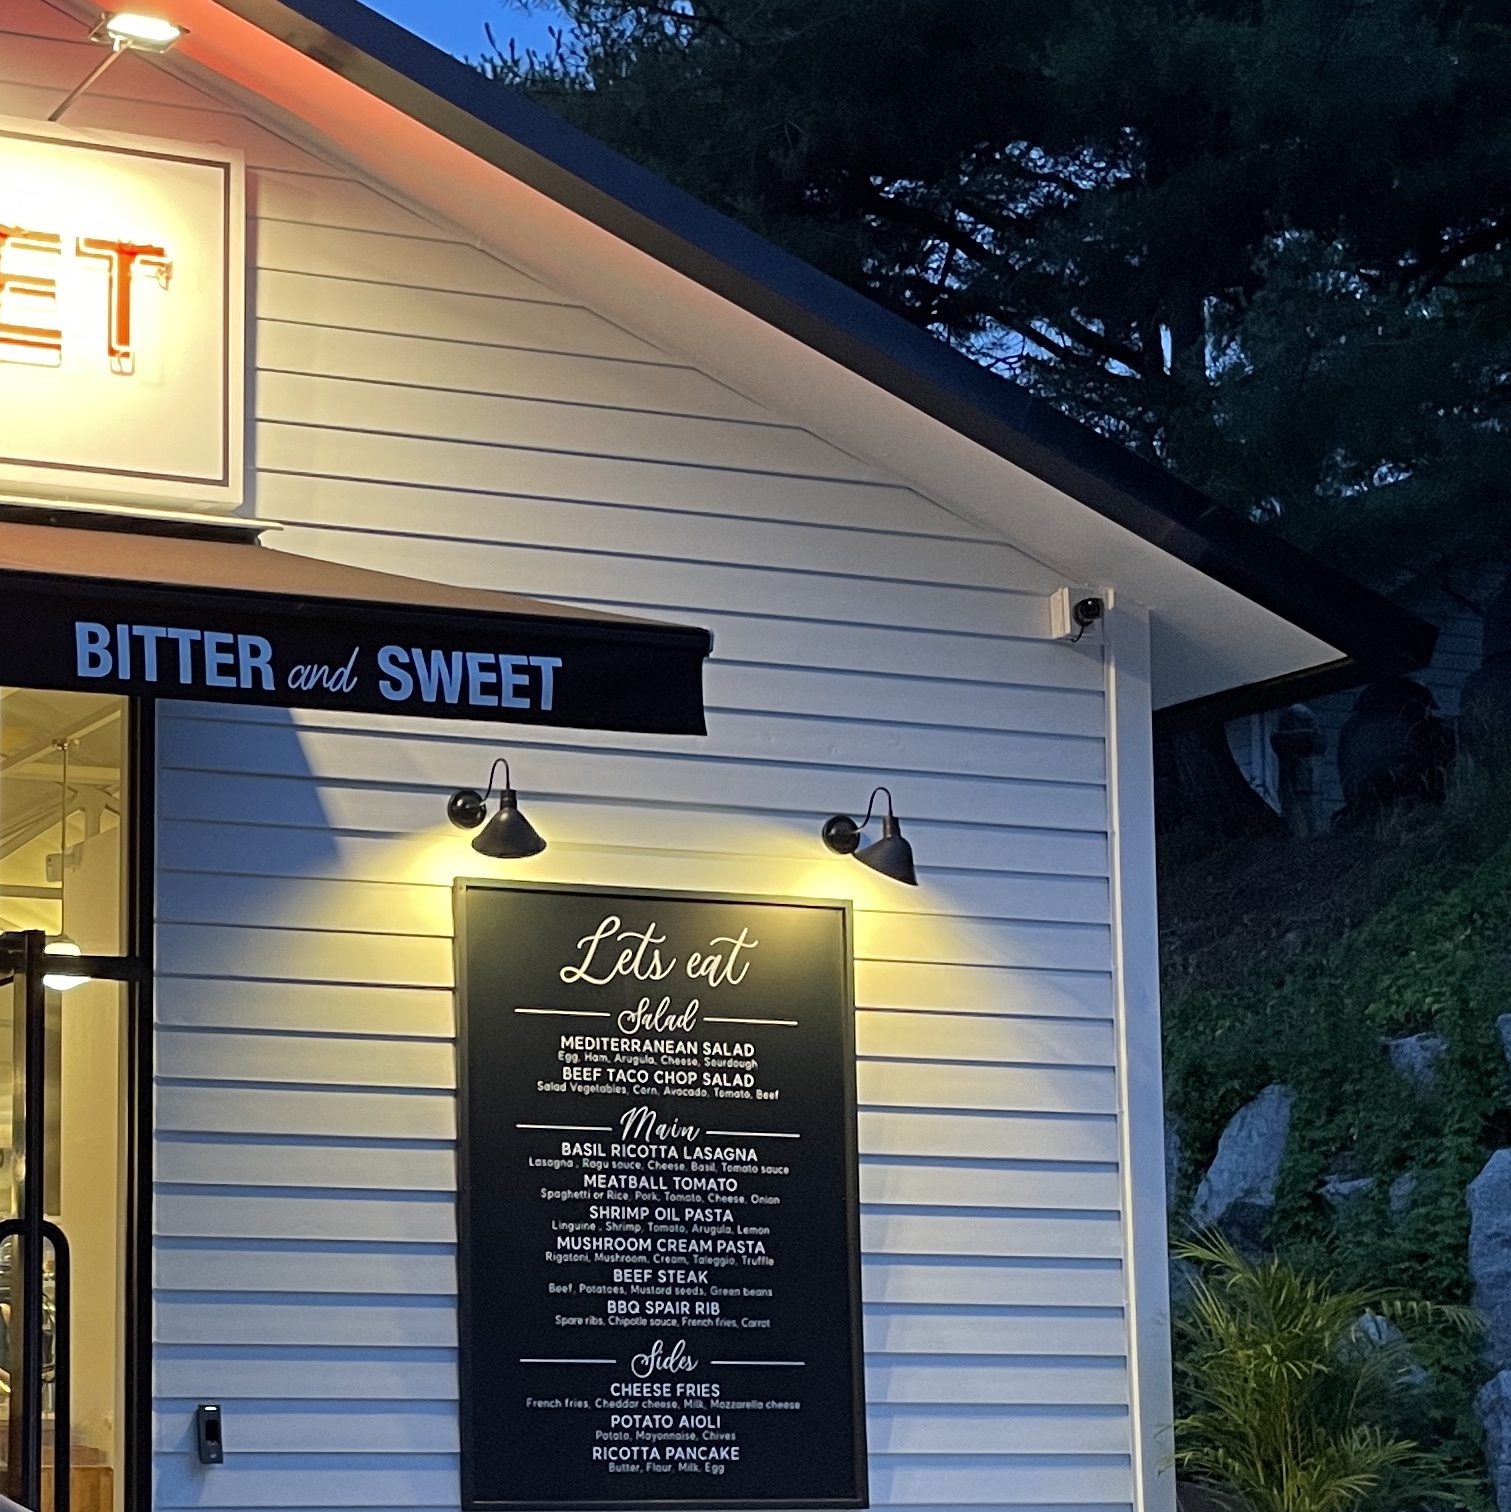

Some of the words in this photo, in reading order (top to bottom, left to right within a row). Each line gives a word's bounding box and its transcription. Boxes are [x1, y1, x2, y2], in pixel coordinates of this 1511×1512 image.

[75, 621, 276, 691] BITTER
[287, 645, 360, 694] and
[377, 645, 563, 711] SWEET
[559, 915, 677, 985] Lets
[686, 927, 759, 988] eat
[617, 996, 700, 1035] Salad
[560, 1035, 699, 1055] MEDITERRANEAN
[702, 1041, 755, 1057] SALAD
[562, 1066, 603, 1082] BEEF
[605, 1068, 649, 1084] TACO
[653, 1070, 698, 1086] CHOP
[702, 1072, 755, 1088] SALAD
[619, 1105, 701, 1143] Main
[561, 1142, 607, 1158] BASIL
[610, 1143, 679, 1160] RICOTTA
[683, 1146, 759, 1162] LASAGNA
[583, 1174, 669, 1190] MEATBALL
[672, 1176, 739, 1193] TOMATO
[589, 1205, 650, 1221] SHRIMP
[654, 1207, 681, 1222] OIL
[684, 1208, 735, 1223] PASTA
[556, 1235, 652, 1252] MUSHROOM
[656, 1238, 713, 1253] CREAM
[716, 1239, 766, 1255] PASTA
[612, 1268, 653, 1283] BEEF
[656, 1269, 709, 1284] STEAK
[606, 1300, 641, 1315] BBQ
[644, 1301, 691, 1315] SPAIR
[694, 1301, 721, 1315] RIB
[631, 1339, 700, 1379] Sides
[609, 1382, 672, 1397] CHEESE
[675, 1383, 721, 1398] FRIES
[610, 1415, 674, 1428] POTATO
[678, 1415, 721, 1428] AIOLI
[592, 1447, 662, 1460] RICOTTA
[665, 1446, 740, 1460] PANCAKE
